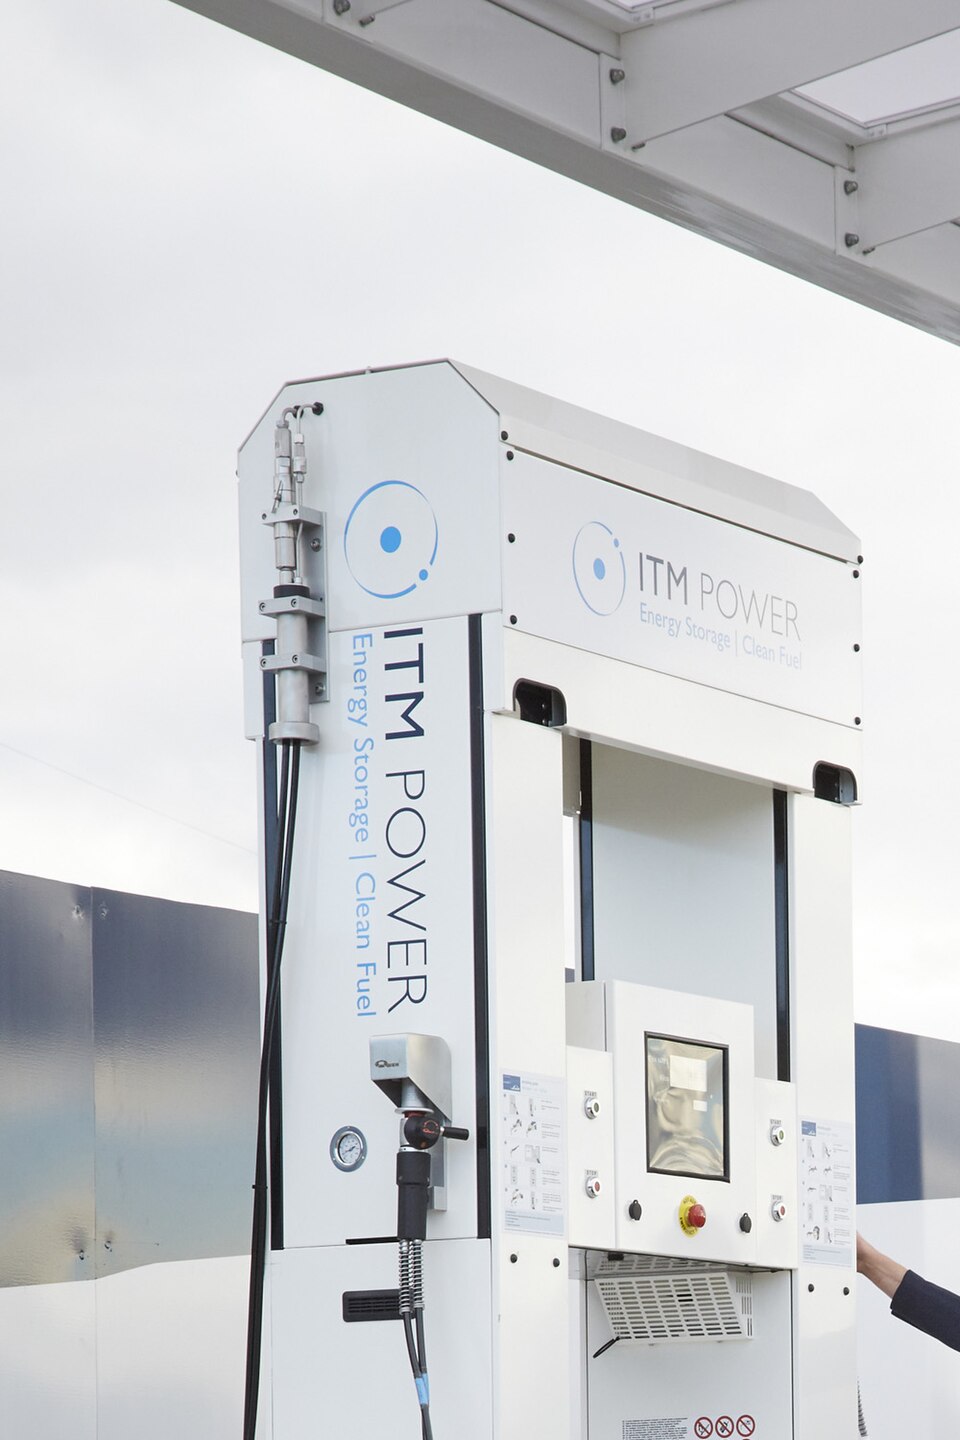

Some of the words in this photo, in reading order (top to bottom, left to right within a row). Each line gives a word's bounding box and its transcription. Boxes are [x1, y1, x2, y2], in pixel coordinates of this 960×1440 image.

[639, 552, 688, 606] ITM
[700, 572, 801, 641] POWER
[640, 602, 681, 638] Energy
[685, 616, 731, 652] Storage
[742, 634, 776, 662] Clean
[779, 645, 802, 670] Fuel
[347, 633, 373, 728] Energy
[383, 627, 425, 741] ITM
[349, 737, 374, 842] Storage
[355, 872, 376, 949] Clean
[385, 769, 427, 1014] POWER
[356, 962, 377, 1017] Fuel
